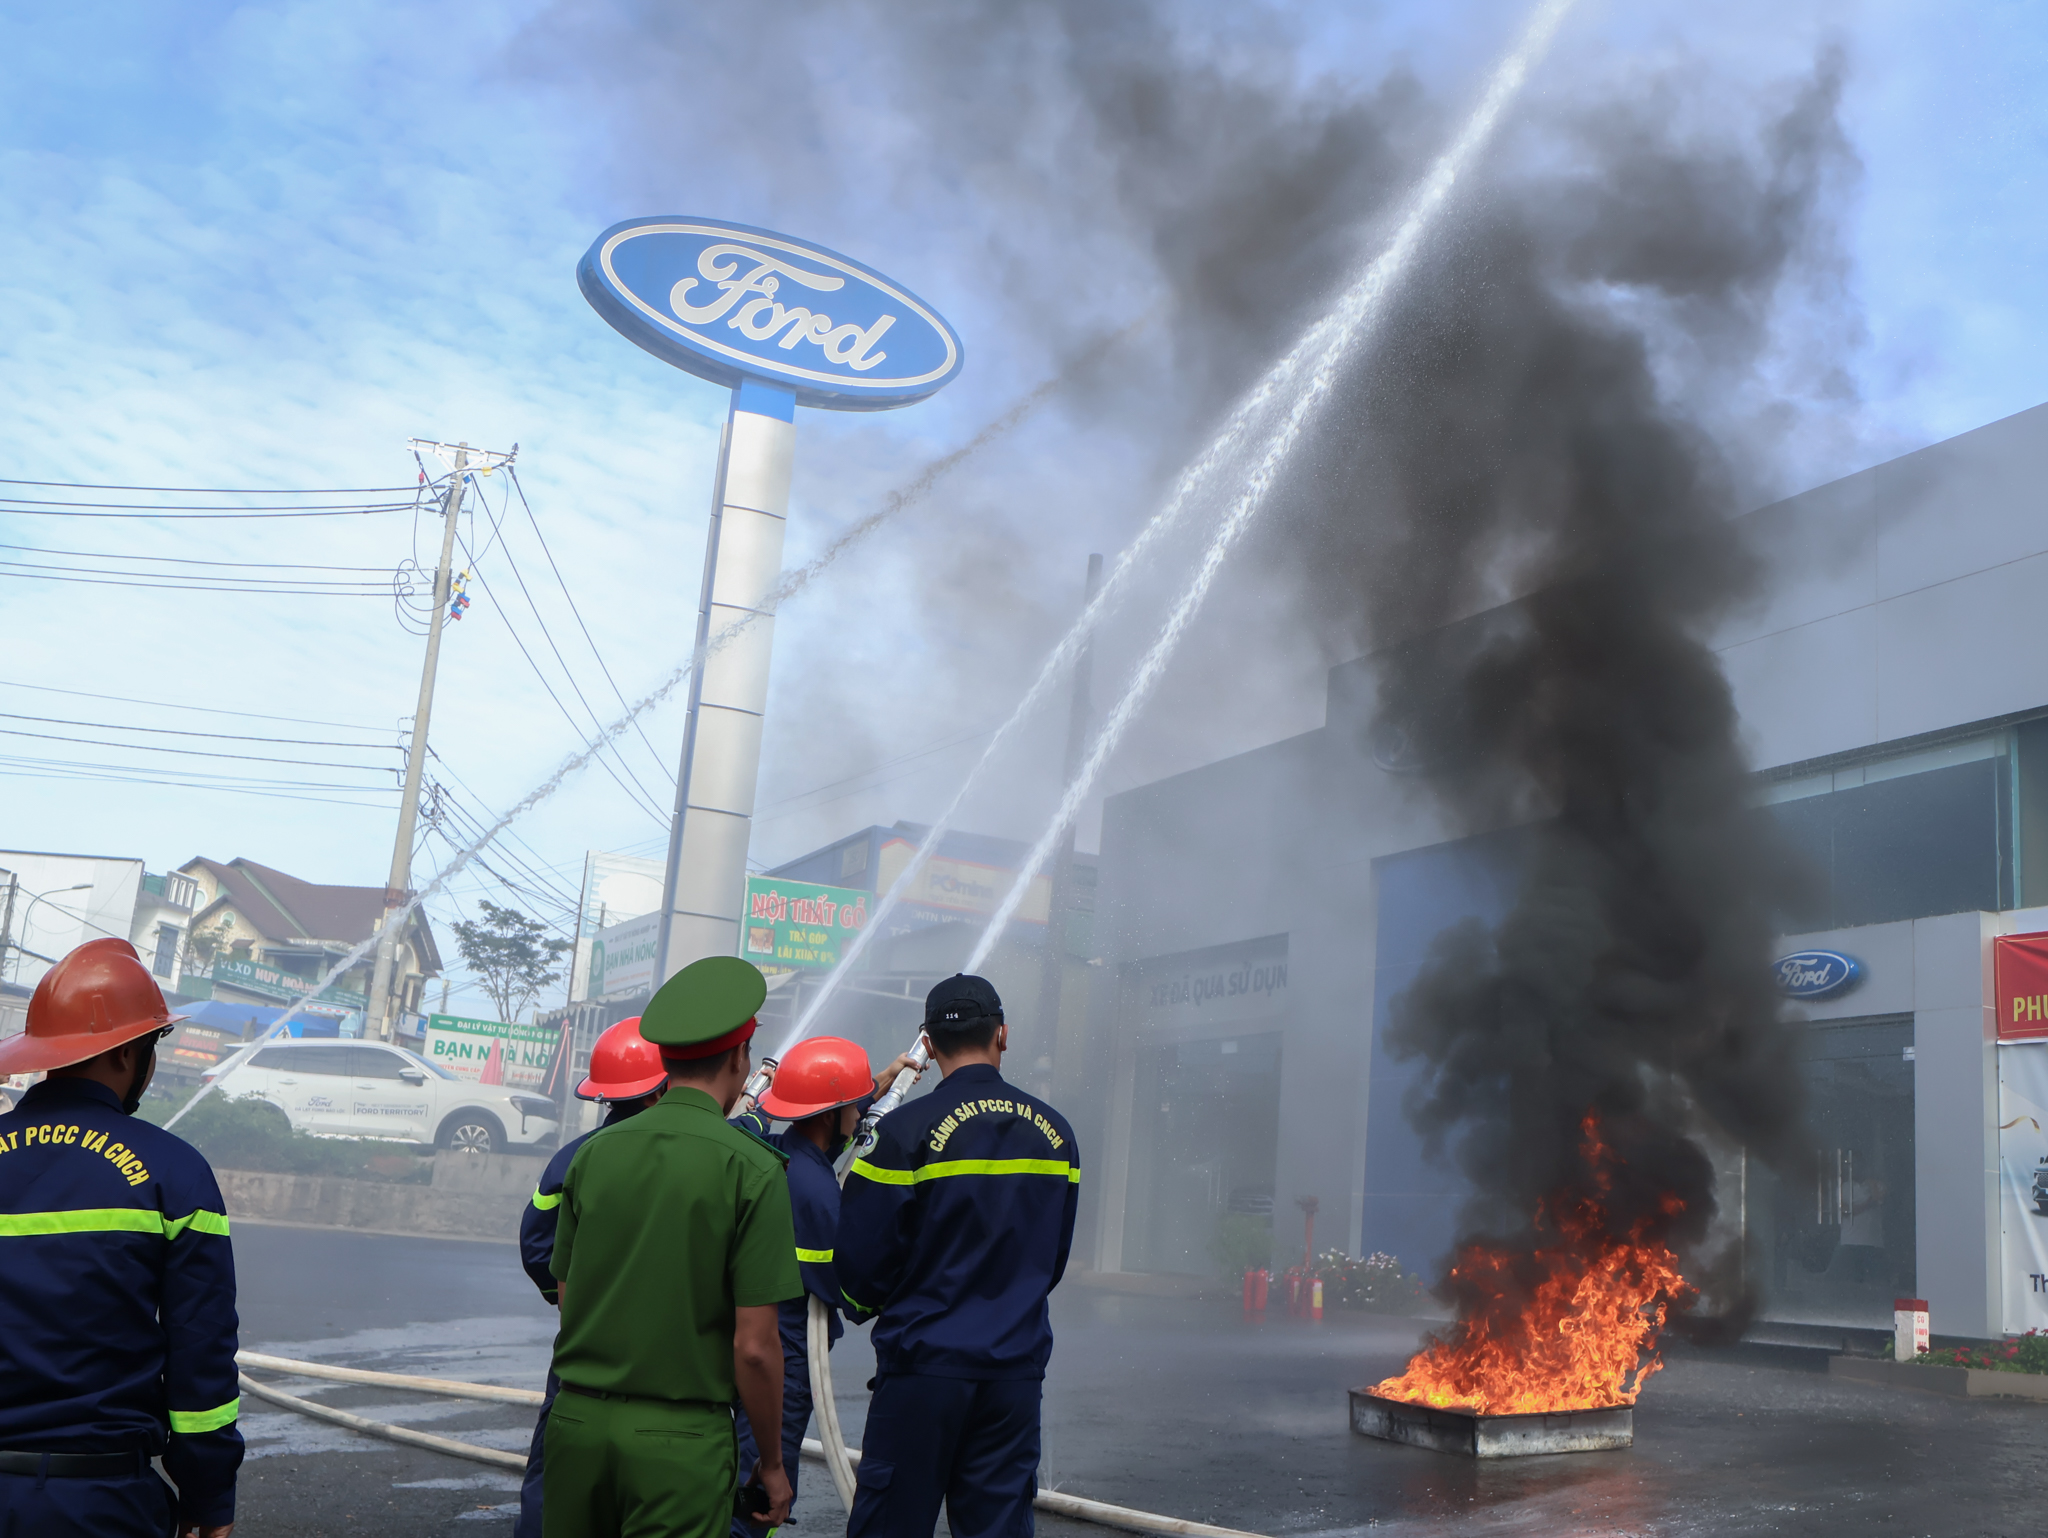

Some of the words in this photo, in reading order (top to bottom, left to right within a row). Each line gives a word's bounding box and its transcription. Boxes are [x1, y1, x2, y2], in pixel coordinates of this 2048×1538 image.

[670, 244, 897, 371] Ford
[750, 889, 787, 925] NỘI
[790, 893, 837, 927] THẤT
[839, 896, 868, 930] GỖ
[789, 928, 806, 942] TRẢ
[808, 931, 828, 945] GÓP
[777, 945, 793, 959] LÃI
[219, 957, 252, 976] VLXD
[254, 967, 281, 988] HUY
[1193, 974, 1225, 1007] QUA
[1253, 963, 1288, 997] DỤN
[1777, 958, 1832, 987] Ford
[457, 1020, 471, 1031] ĐẠI
[472, 1021, 482, 1030] LÝ
[482, 1023, 497, 1034] VẬT
[945, 1012, 959, 1020] 114
[433, 1039, 473, 1061] BẠN
[307, 1096, 334, 1108] Ford
[380, 1108, 425, 1116] TERRITORY
[929, 1114, 960, 1152] CẢNH
[954, 1101, 979, 1122] SÁT
[978, 1099, 1013, 1113] PCCC
[1016, 1102, 1033, 1121] VÀ
[1033, 1113, 1064, 1150] CNCH
[0, 1131, 18, 1154] ÁT
[25, 1124, 80, 1146] PCCC
[80, 1129, 110, 1153] VÀ
[103, 1142, 150, 1187] CNCH
